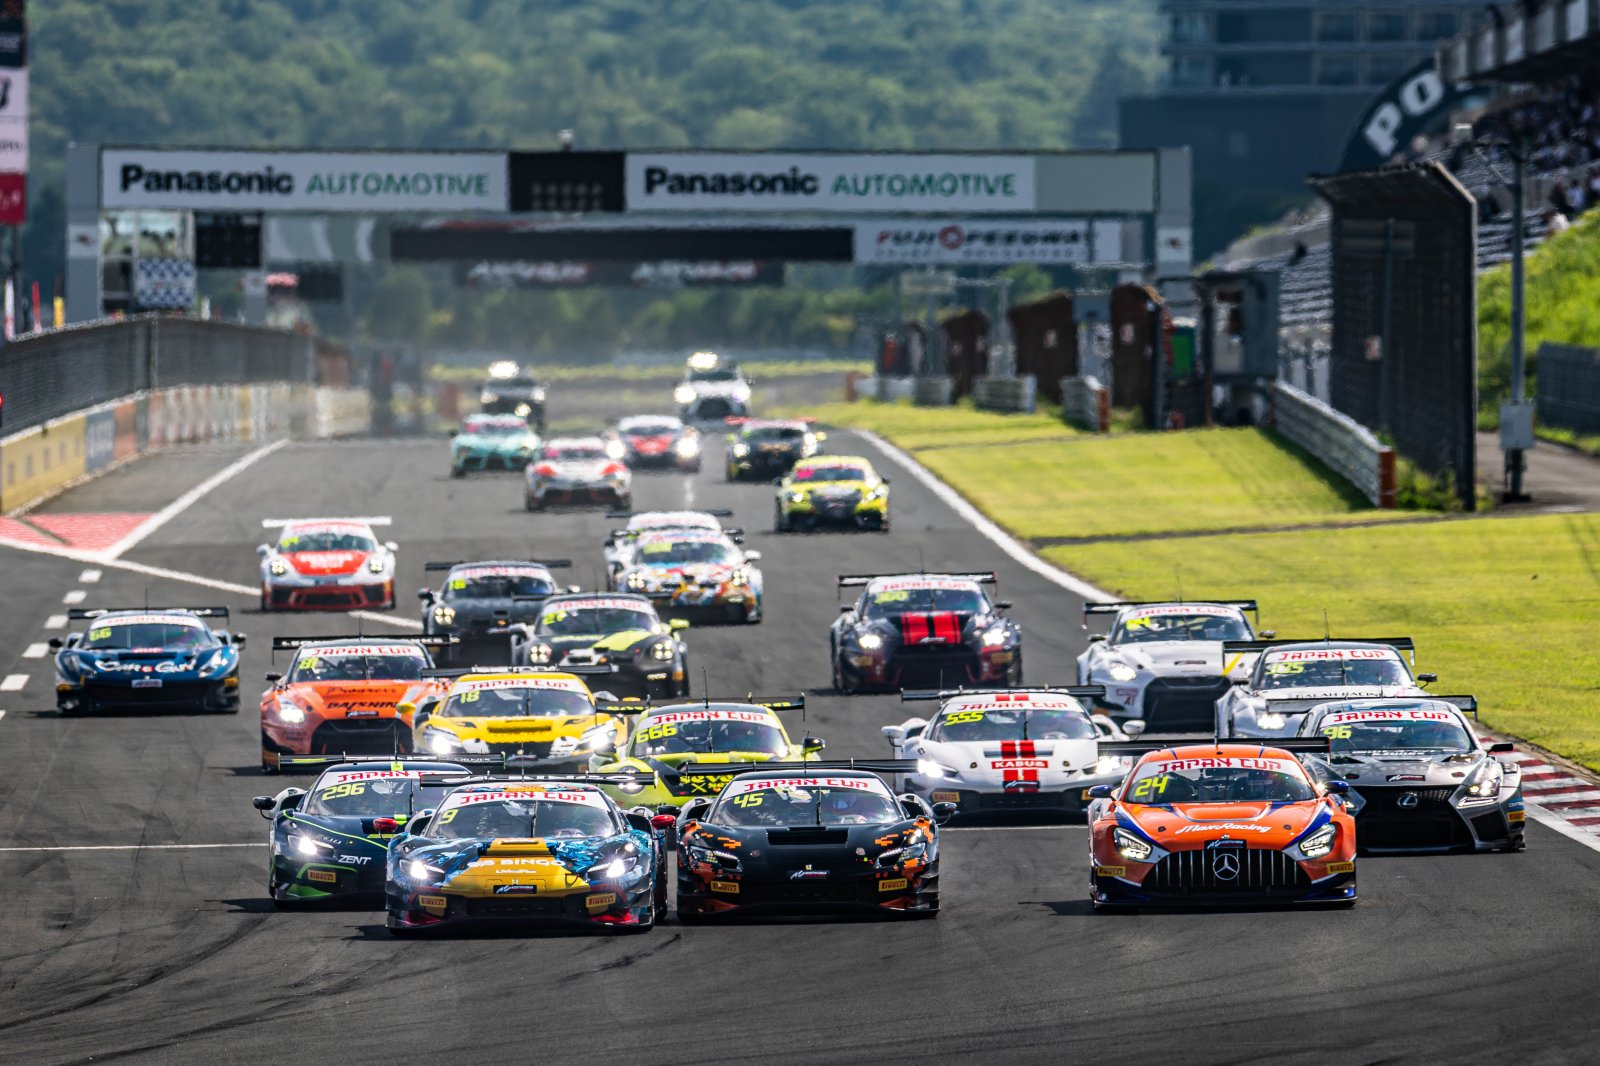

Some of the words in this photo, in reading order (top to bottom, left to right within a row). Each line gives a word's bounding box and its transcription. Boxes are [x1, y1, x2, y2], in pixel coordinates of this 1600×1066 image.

[120, 164, 294, 195] Panasonic
[305, 172, 490, 195] AUTOMOTIVE
[644, 166, 819, 196] Panasonic
[832, 172, 1016, 197] AUTOMOTIVE
[312, 646, 372, 656] JAPAN
[378, 646, 413, 656] CUP
[1278, 650, 1344, 662] JAPAN
[1348, 650, 1386, 659] CUP
[469, 679, 528, 691] JAPAN
[534, 679, 570, 689] CUP
[460, 689, 481, 704] 18
[957, 700, 1026, 712] JAPAN
[1031, 700, 1069, 710] CUP
[653, 710, 720, 725] JAPAN
[725, 710, 765, 722] CUP
[944, 711, 985, 726] 555
[1333, 710, 1403, 723] JAPAN
[1409, 710, 1449, 720] CUP
[635, 723, 677, 744] 666
[1323, 725, 1352, 740] 96
[1157, 757, 1233, 774] JAPAN
[1240, 757, 1283, 771] CUP
[337, 770, 409, 783] JAPAN
[322, 782, 367, 801] 296
[743, 777, 820, 792] JAPAN
[826, 777, 869, 789] CUP
[1135, 776, 1168, 797] 24
[460, 790, 536, 805] JAPAN
[541, 790, 587, 802] CUP
[733, 792, 765, 808] 45
[437, 808, 459, 825] 9
[338, 854, 372, 866] ZENT
[500, 858, 566, 868] BINGO
[308, 871, 335, 882] PIRELLI
[881, 880, 906, 891] PIRELLI
[421, 897, 445, 907] PIRELLI
[588, 895, 615, 906] PIRELLI
